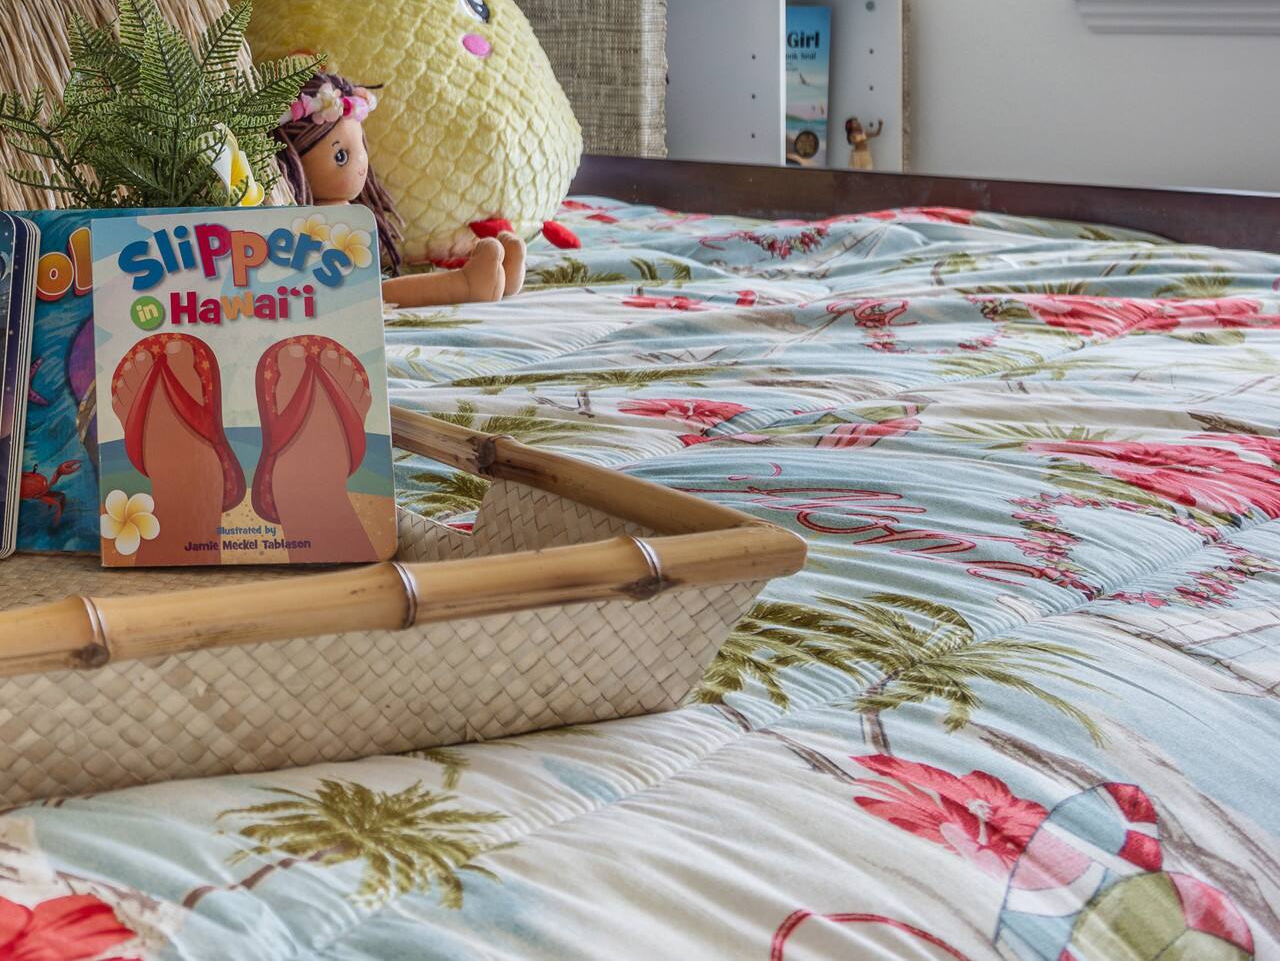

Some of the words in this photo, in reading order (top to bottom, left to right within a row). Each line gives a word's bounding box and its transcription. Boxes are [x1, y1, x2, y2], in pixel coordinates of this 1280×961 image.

[787, 31, 820, 48] Girl
[136, 303, 159, 323] in
[264, 525, 277, 537] by
[184, 541, 220, 552] Jamie
[222, 539, 258, 551] Meckel
[262, 539, 312, 550] Tablason
